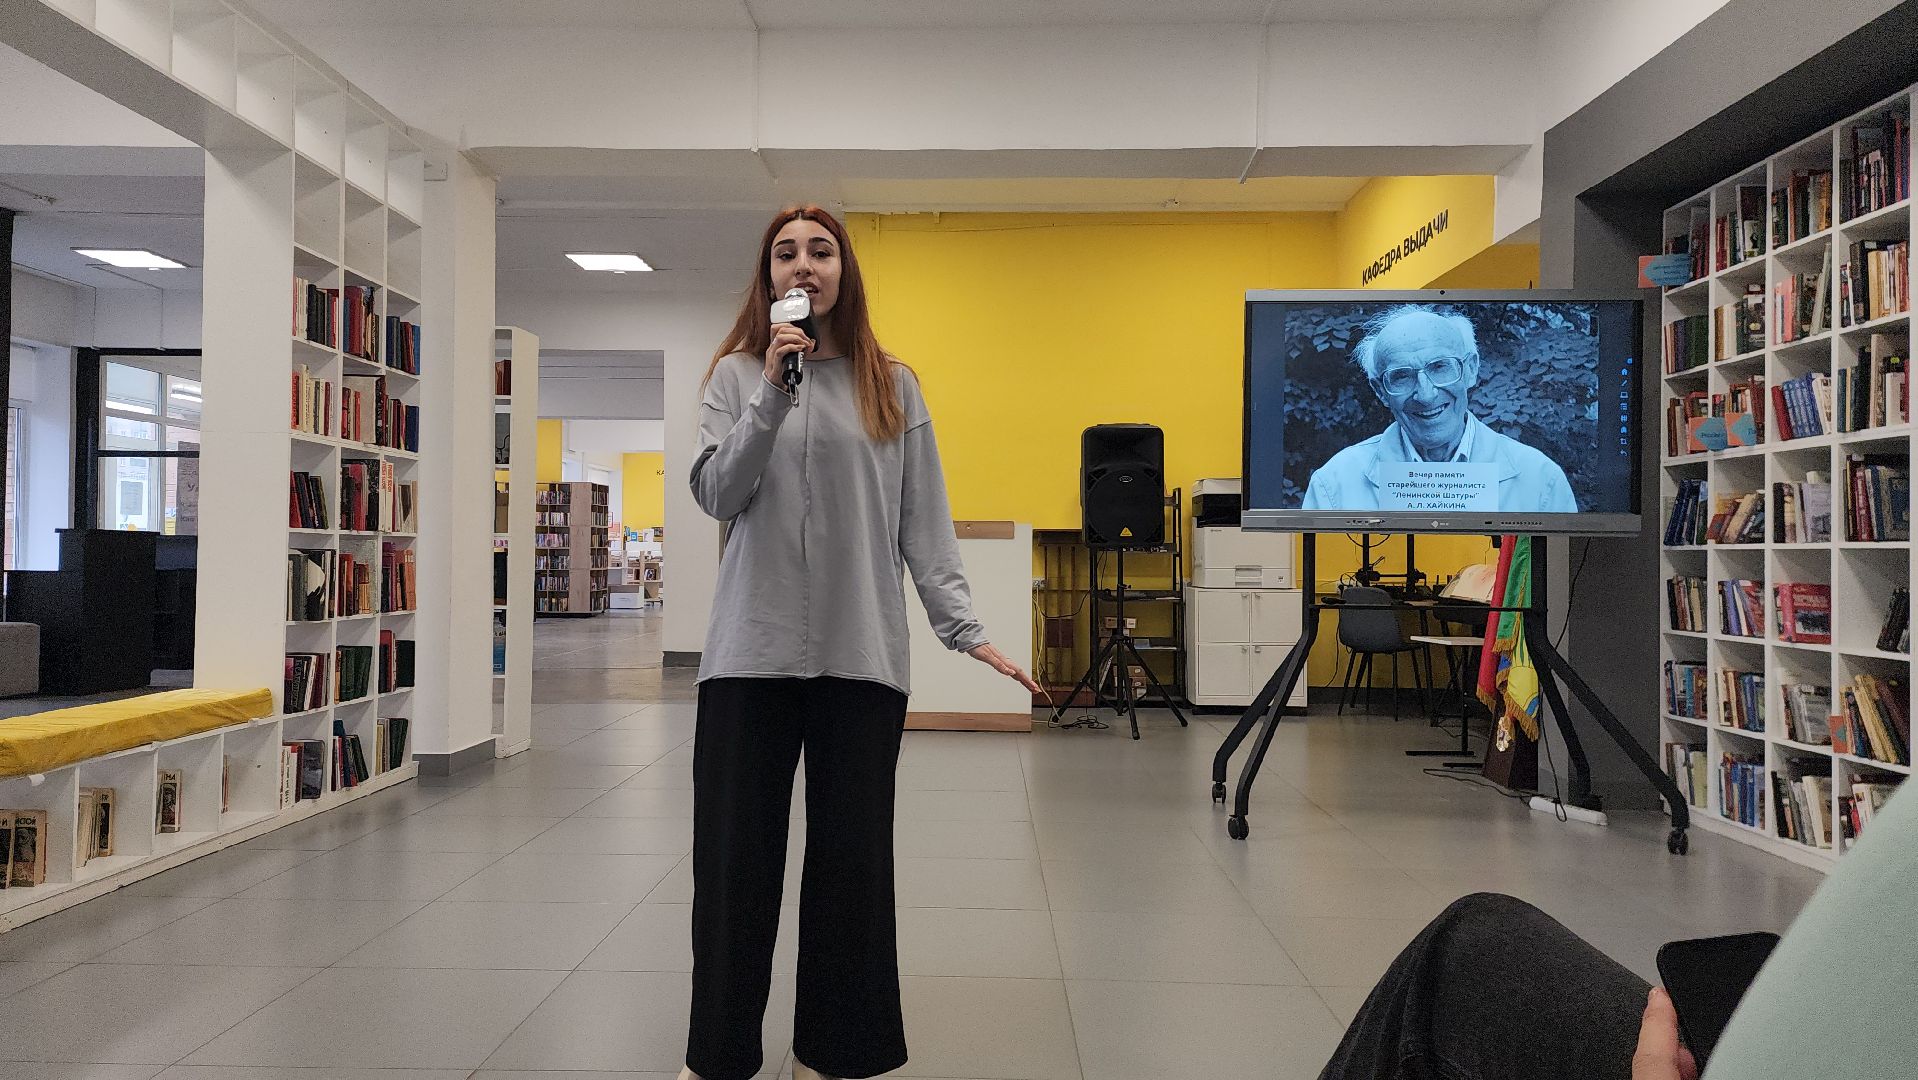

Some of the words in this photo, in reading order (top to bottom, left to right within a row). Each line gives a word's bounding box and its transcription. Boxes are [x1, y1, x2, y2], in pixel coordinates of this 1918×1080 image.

[1362, 245, 1402, 287] КАФЕДРА
[1403, 208, 1449, 257] ВЫДАЧИ
[1408, 471, 1433, 479] Вечер
[1387, 481, 1436, 489] старейшего
[1437, 482, 1486, 490] журналиста
[1426, 501, 1466, 509] ХАЙКИНА
